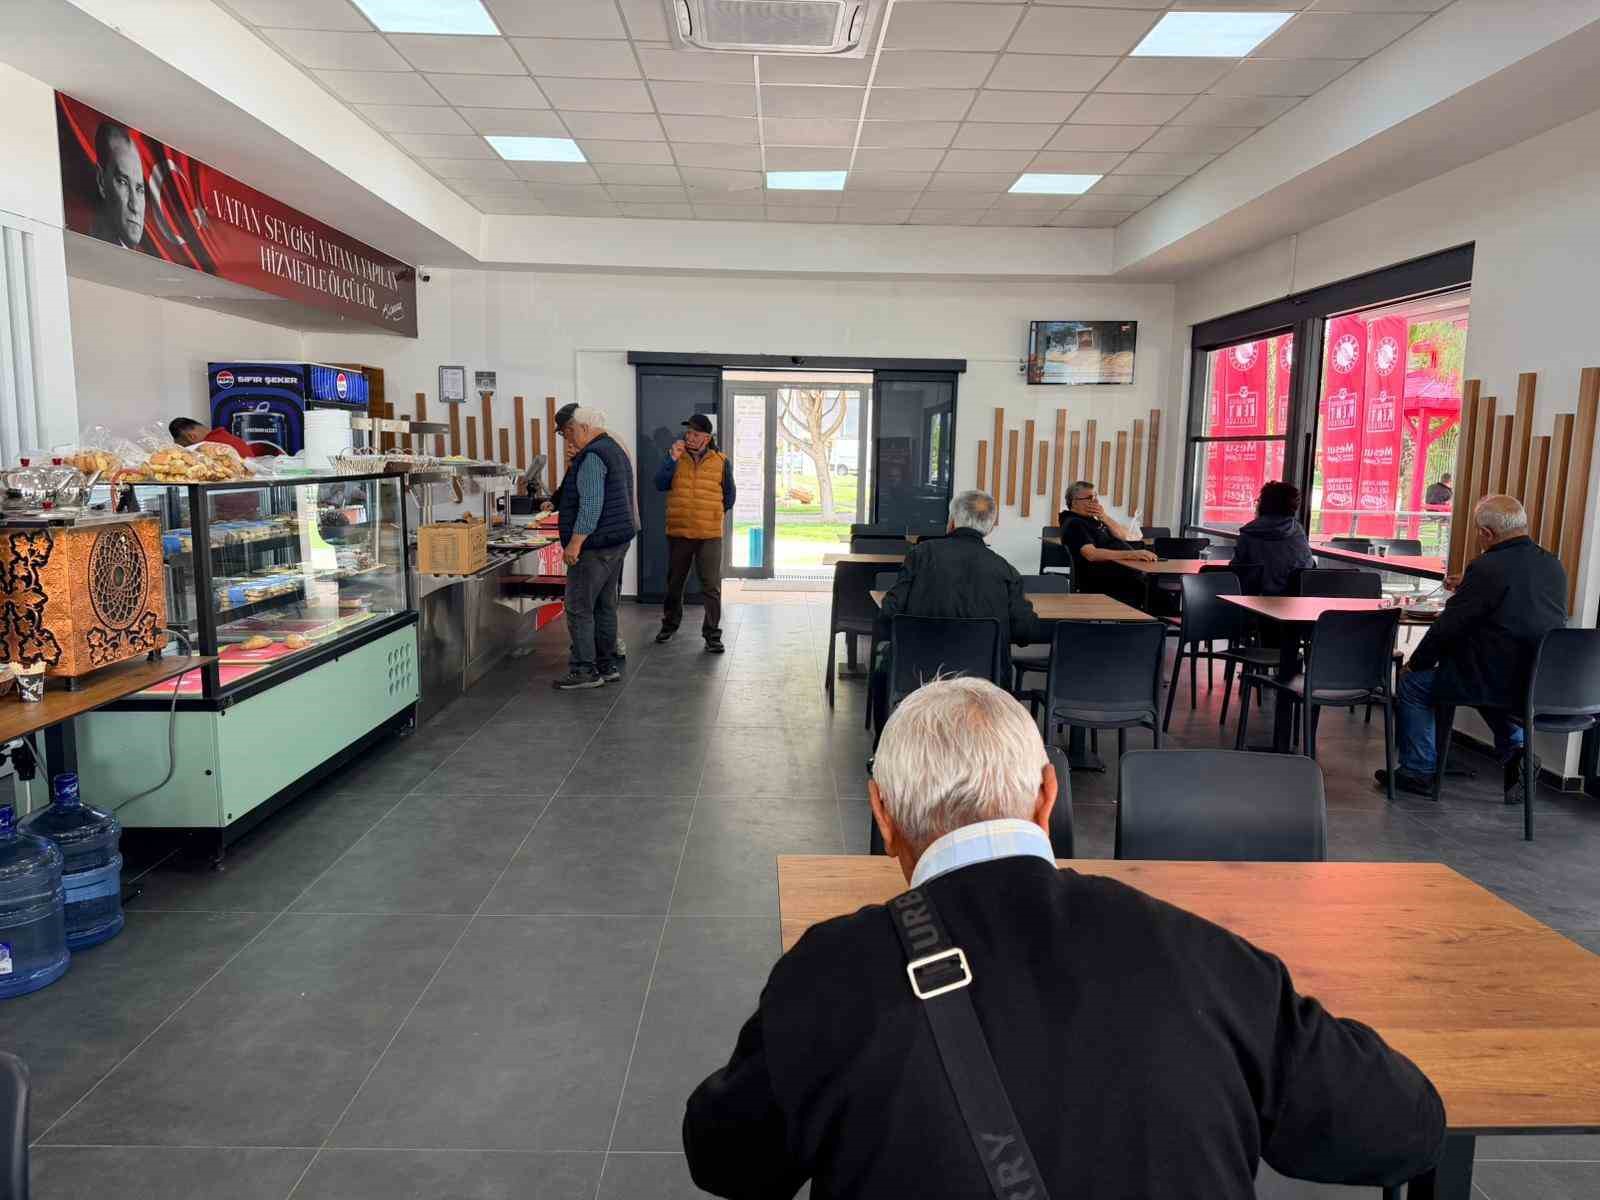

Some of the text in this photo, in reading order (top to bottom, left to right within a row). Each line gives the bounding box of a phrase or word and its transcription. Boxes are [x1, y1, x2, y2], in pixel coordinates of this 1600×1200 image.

[213, 190, 261, 235] VATAN
[360, 256, 398, 293] YAPILAN
[260, 245, 328, 293] HİZMETLE
[237, 376, 263, 384] SIFIR
[264, 376, 298, 385] ŞEKER
